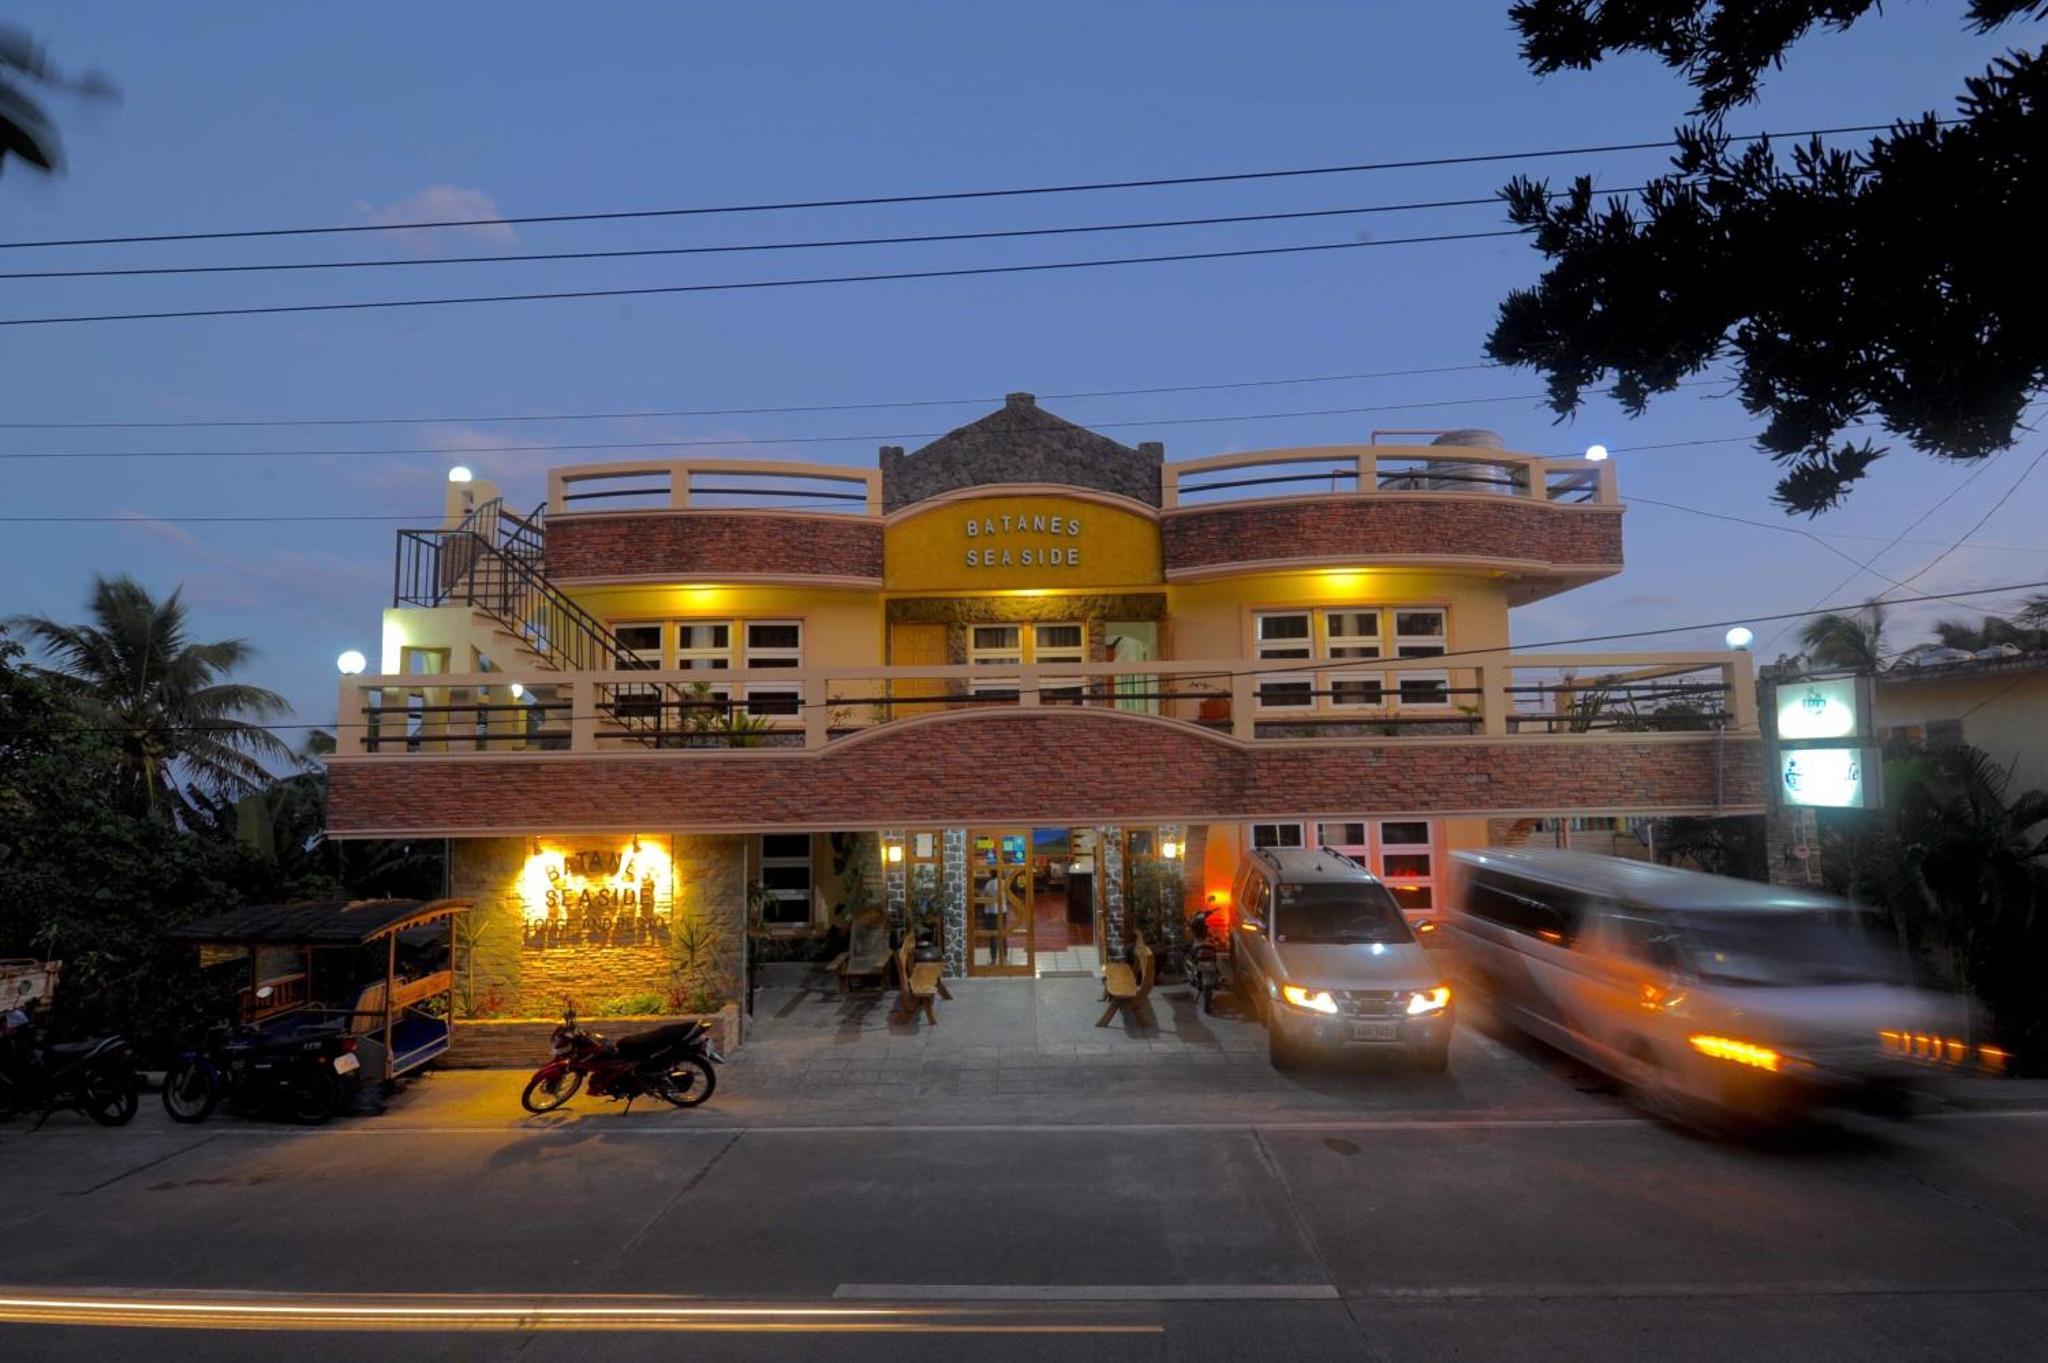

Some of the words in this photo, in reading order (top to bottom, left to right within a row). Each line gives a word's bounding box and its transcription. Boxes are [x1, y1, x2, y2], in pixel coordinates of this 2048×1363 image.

[966, 516, 1080, 536] BATANES
[966, 549, 1080, 566] SEASIDE
[546, 888, 651, 908] SEASIDE
[583, 917, 612, 930] AND
